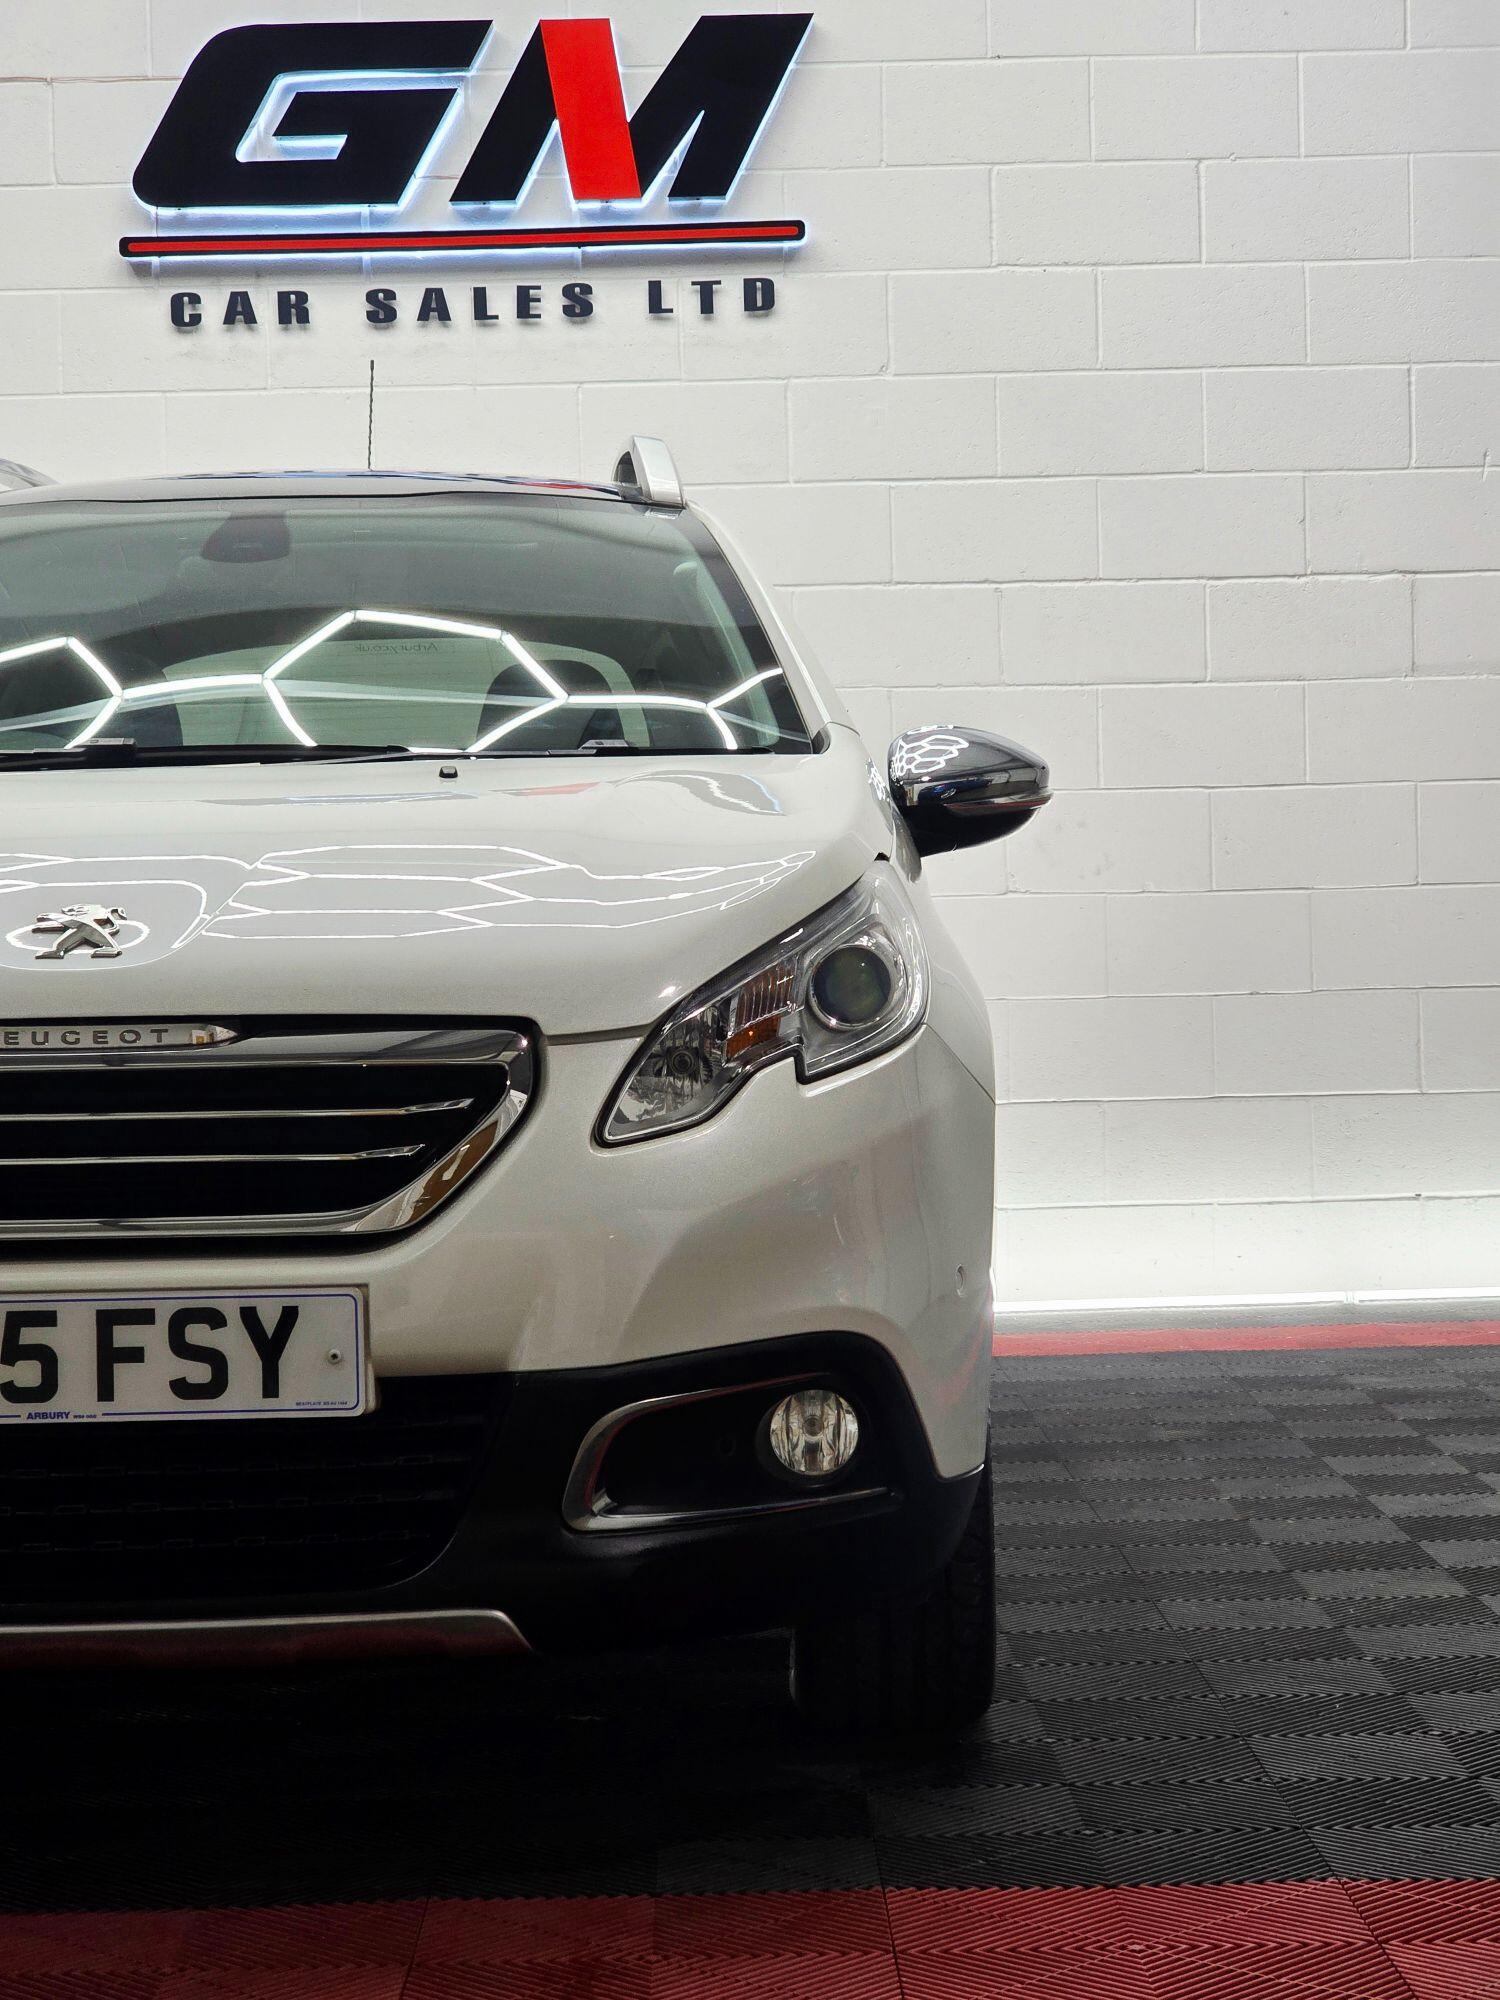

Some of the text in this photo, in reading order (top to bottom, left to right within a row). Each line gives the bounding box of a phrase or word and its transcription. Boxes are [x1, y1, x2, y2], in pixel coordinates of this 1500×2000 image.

[131, 13, 814, 208] GM
[170, 276, 776, 328] CAR SALES LTD
[3, 1028, 169, 1046] EUGEOT
[0, 1305, 299, 1403] 5 FSY
[26, 1411, 71, 1420] ARBURY
